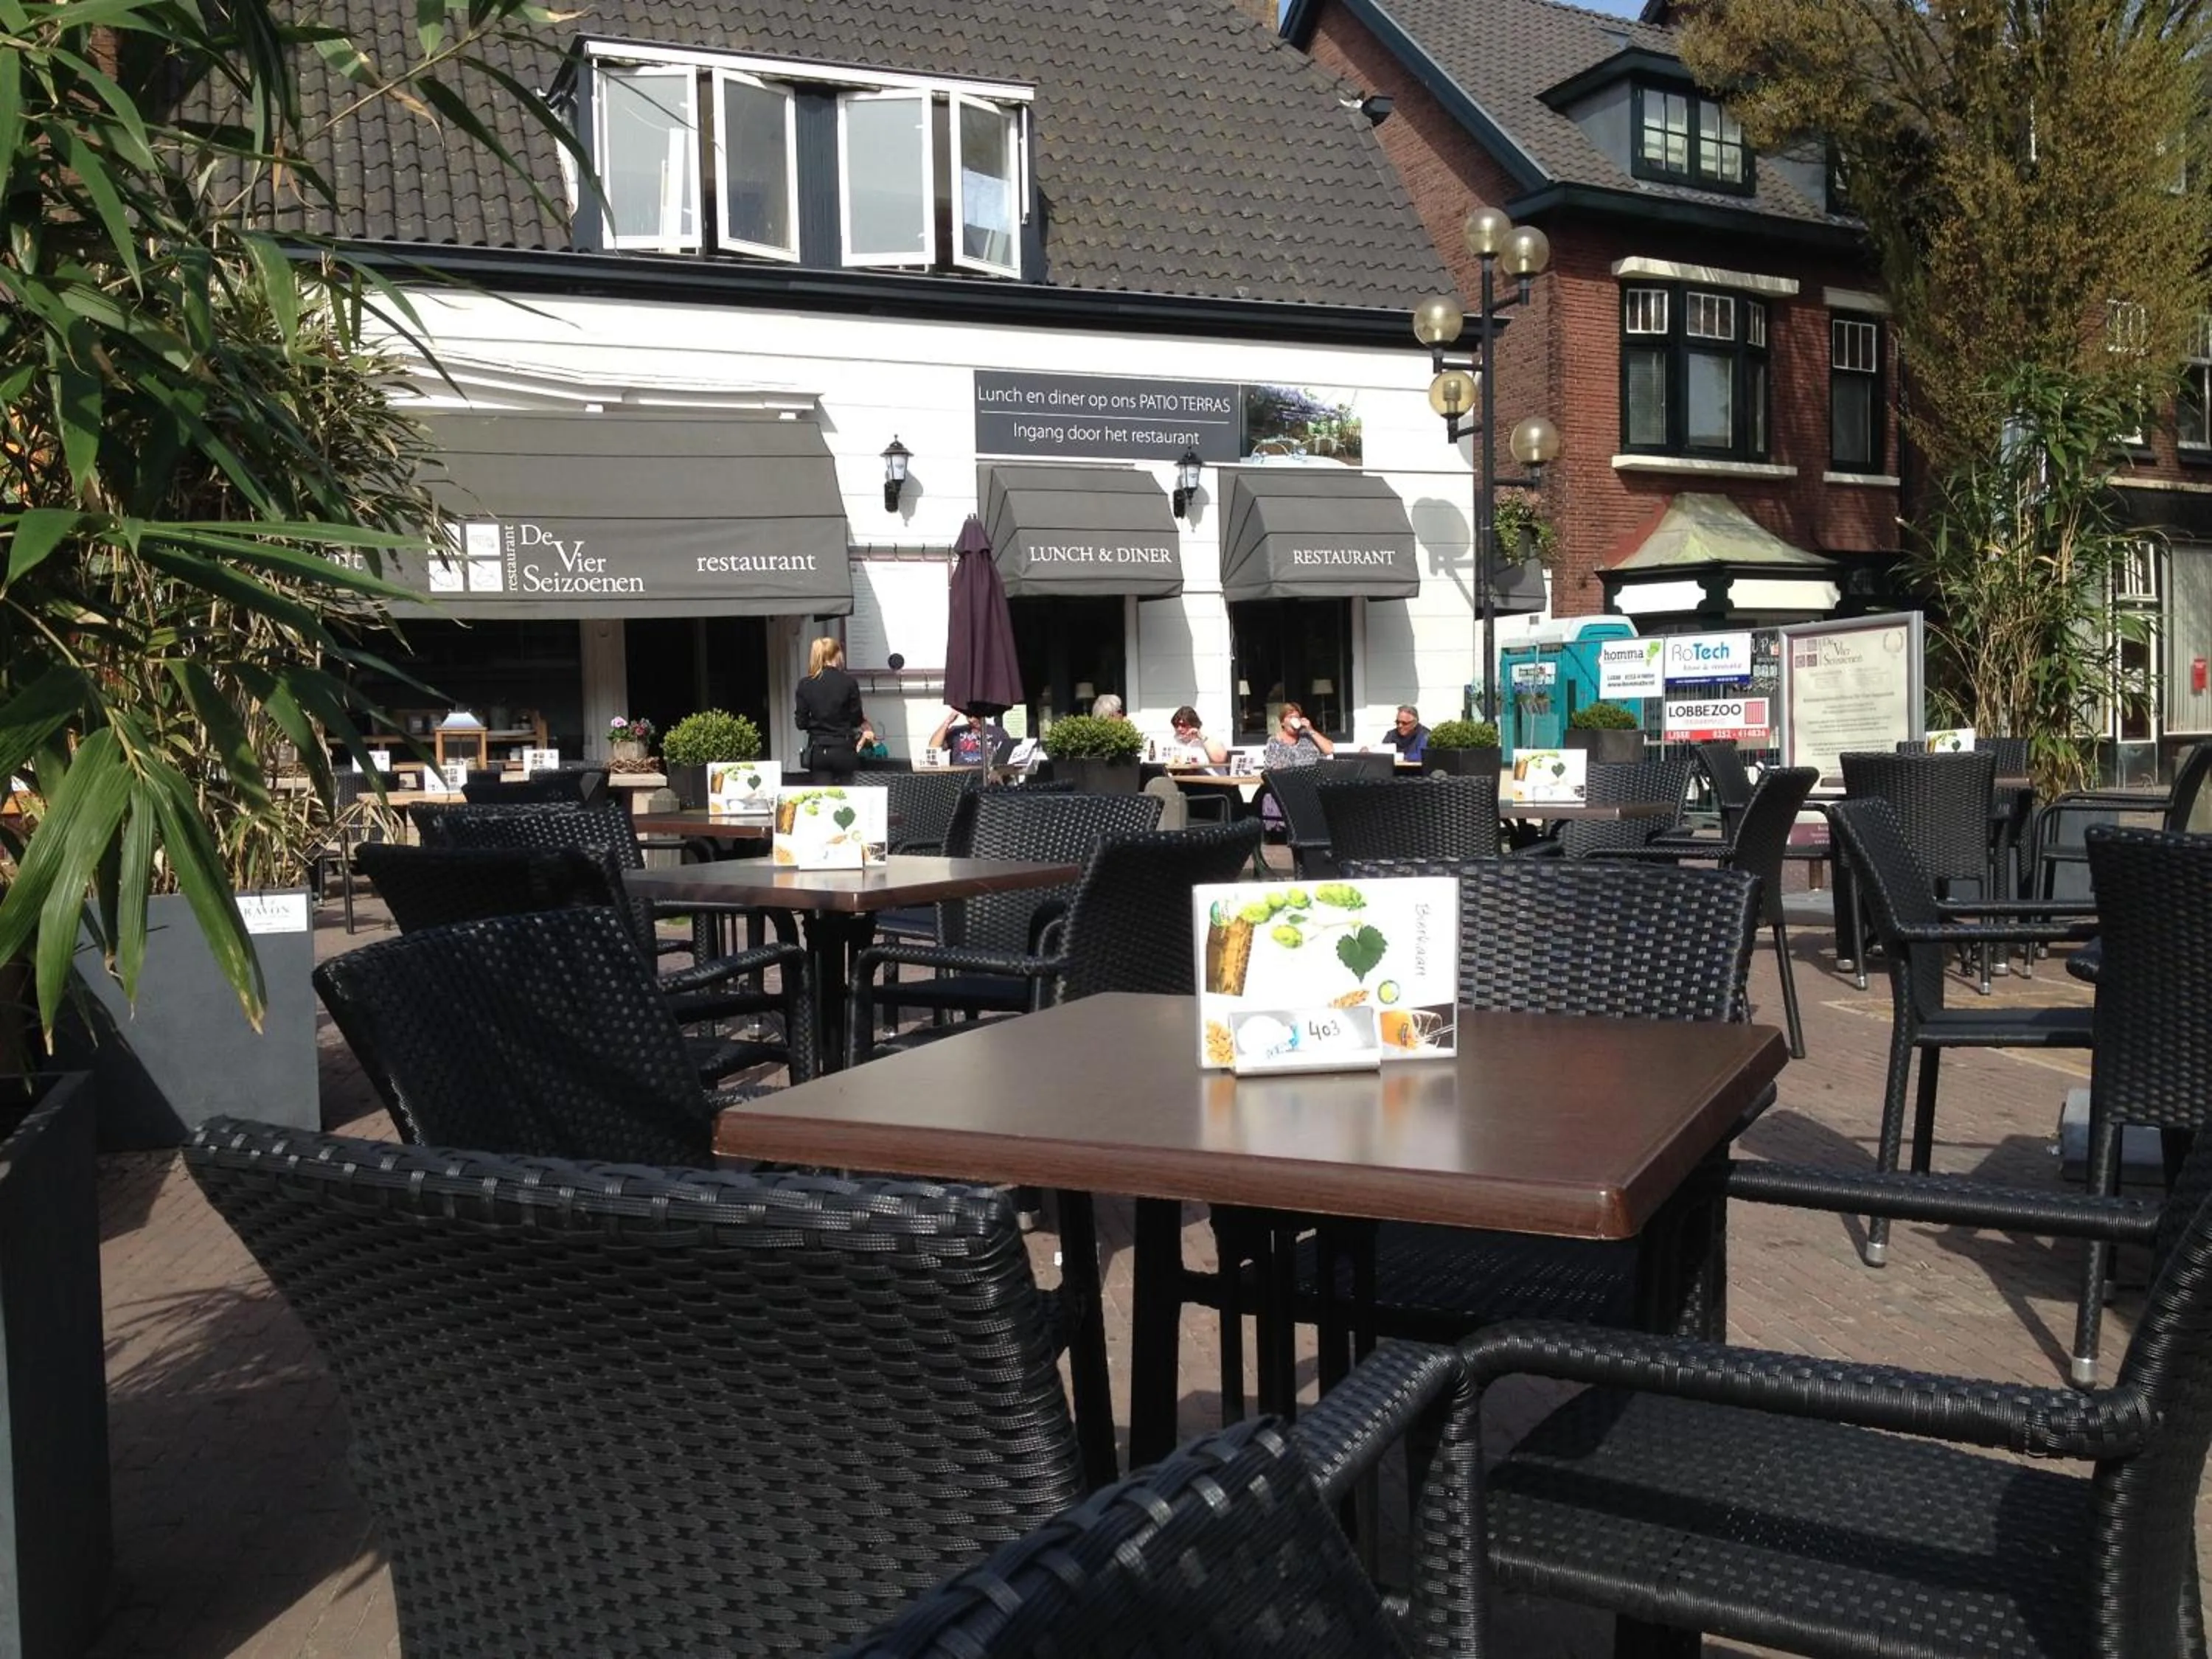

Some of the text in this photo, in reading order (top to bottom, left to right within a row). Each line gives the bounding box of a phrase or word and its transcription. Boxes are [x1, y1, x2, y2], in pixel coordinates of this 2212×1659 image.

[978, 386, 1231, 414] Lunch en diner op ons PATIO TERRAS
[1014, 422, 1200, 445] Ingang door het restaurant
[520, 524, 553, 546] De
[505, 524, 518, 591] restaurant
[551, 540, 607, 574] Vier
[696, 553, 817, 572] restaurant
[1029, 546, 1173, 564] LUNCH & DINER
[1293, 549, 1397, 566] RESTAURANT
[523, 563, 646, 593] Seizoenen
[1603, 648, 1644, 661] homma
[1672, 641, 1730, 661] RoTech
[1669, 703, 1742, 717] LOBBEZOO
[1309, 1020, 1340, 1041] 403
